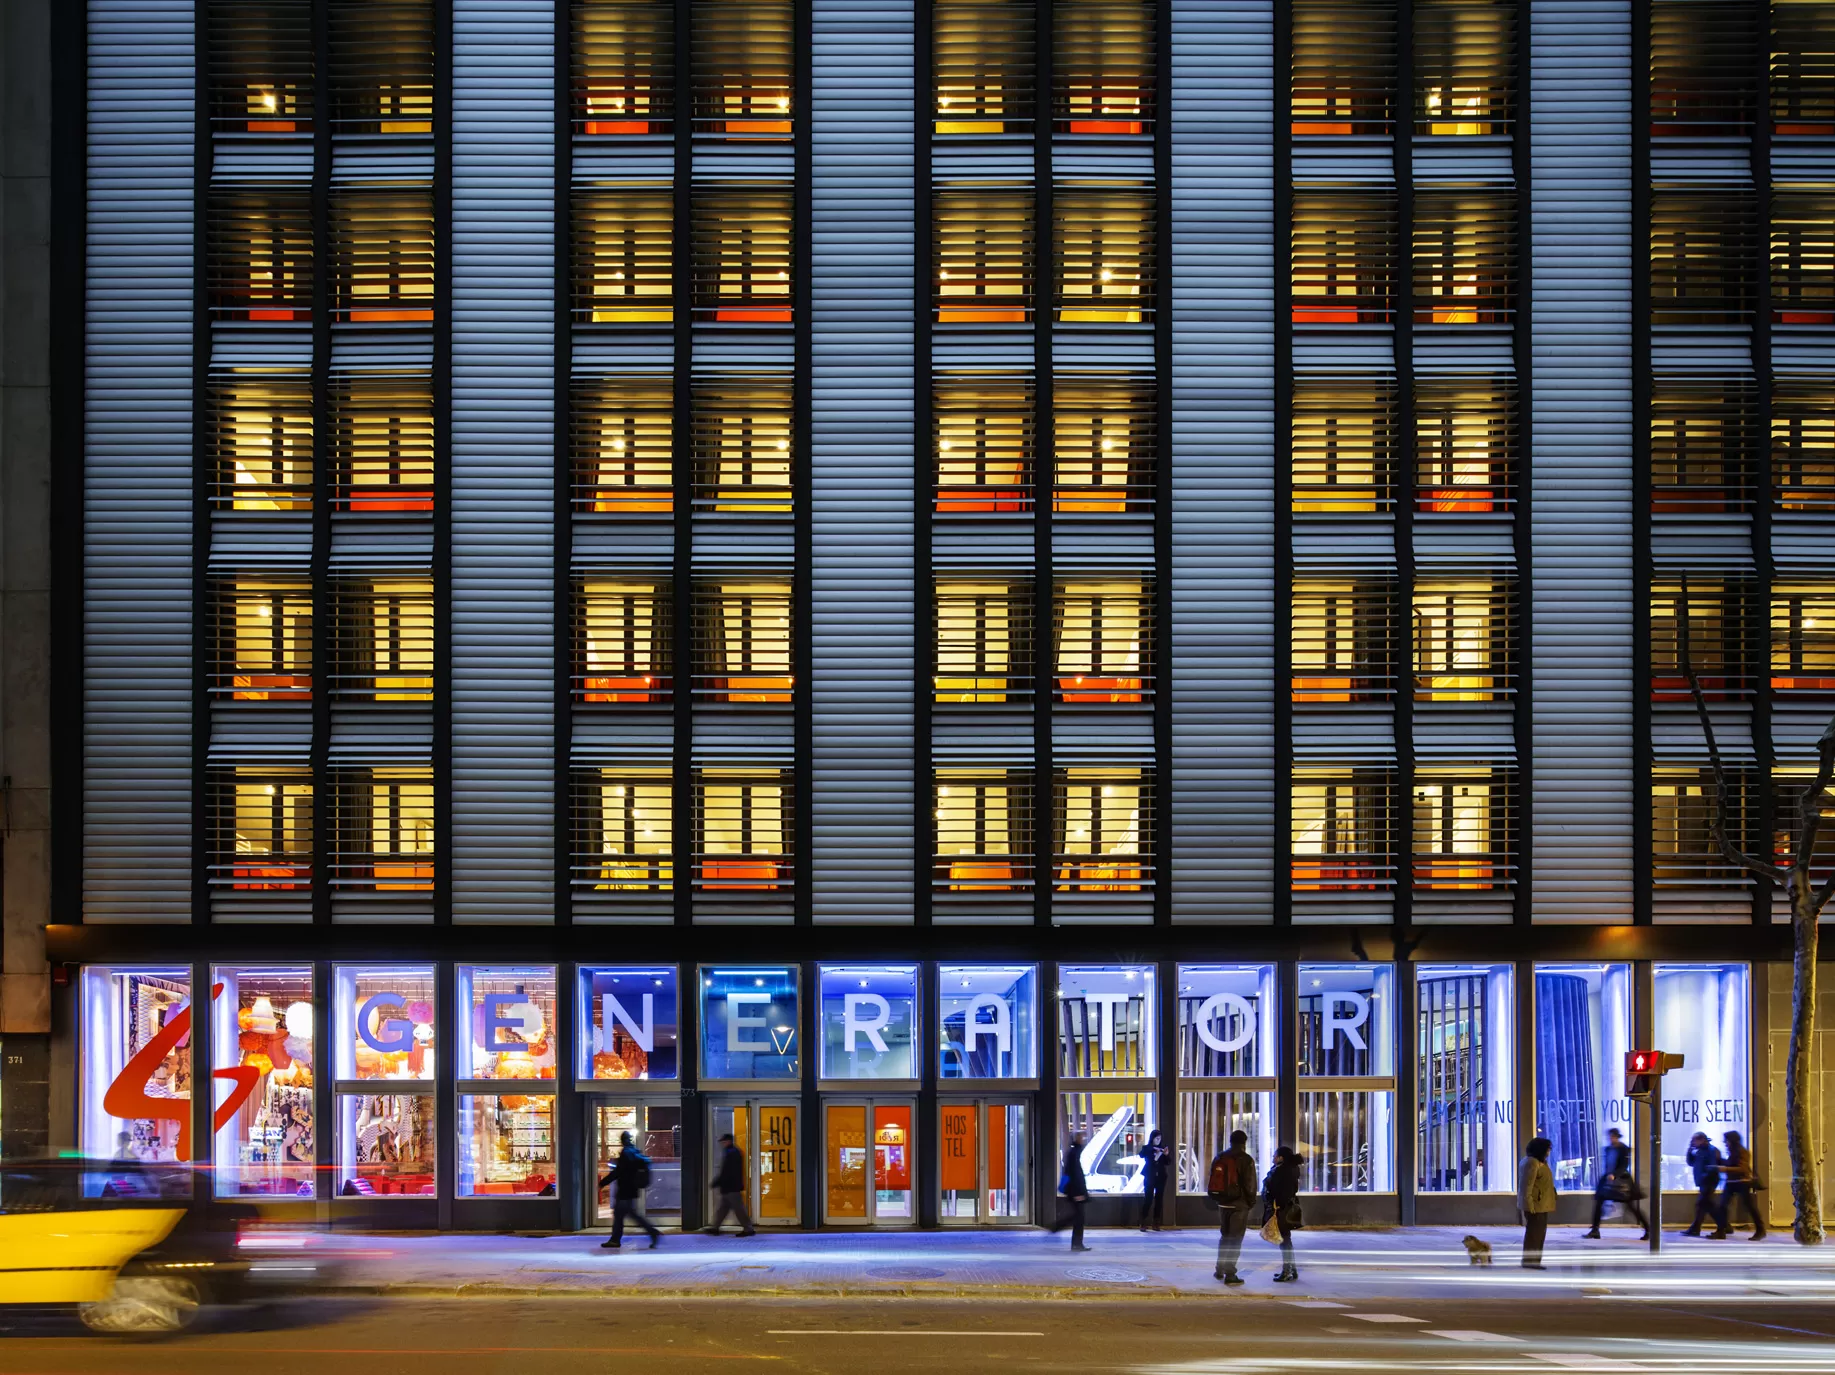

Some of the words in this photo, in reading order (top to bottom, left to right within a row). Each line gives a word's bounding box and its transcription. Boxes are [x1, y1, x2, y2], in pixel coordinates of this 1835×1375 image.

[358, 992, 1370, 1053] GENERATOR
[8, 1056, 23, 1064] 371
[1456, 1100, 1487, 1123] LIKE
[1538, 1099, 1596, 1123] HOSTEL
[1663, 1100, 1699, 1122] EVER
[1705, 1099, 1744, 1122] SEEN
[770, 1116, 792, 1146] HO
[945, 1115, 967, 1135] HOS
[945, 1137, 967, 1157] TEL
[769, 1149, 794, 1173] TEL
